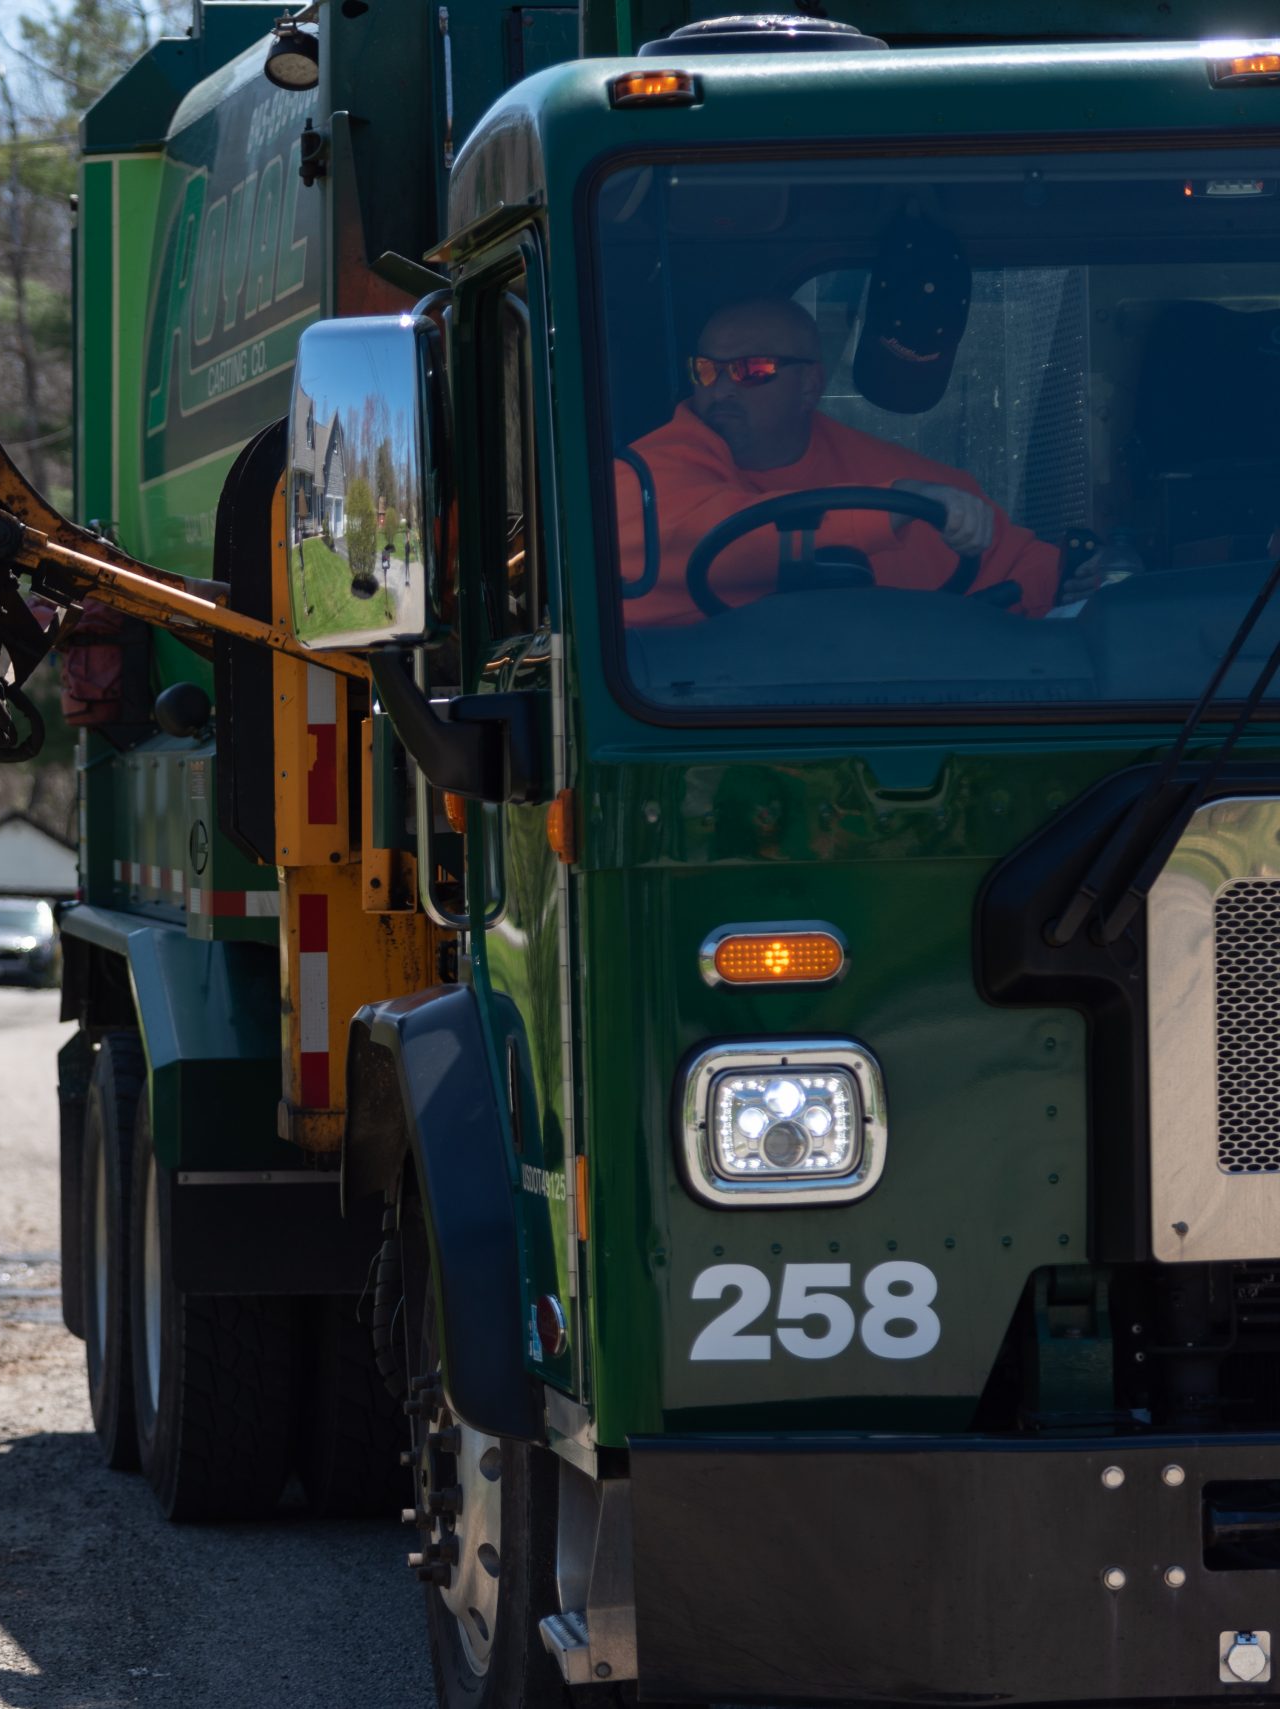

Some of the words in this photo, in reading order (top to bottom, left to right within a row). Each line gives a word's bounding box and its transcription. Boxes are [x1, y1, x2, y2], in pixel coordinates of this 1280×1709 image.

[147, 137, 308, 437] ROYAL
[208, 349, 248, 397] CARTING
[251, 340, 268, 376] CO.
[690, 1260, 941, 1360] 258
